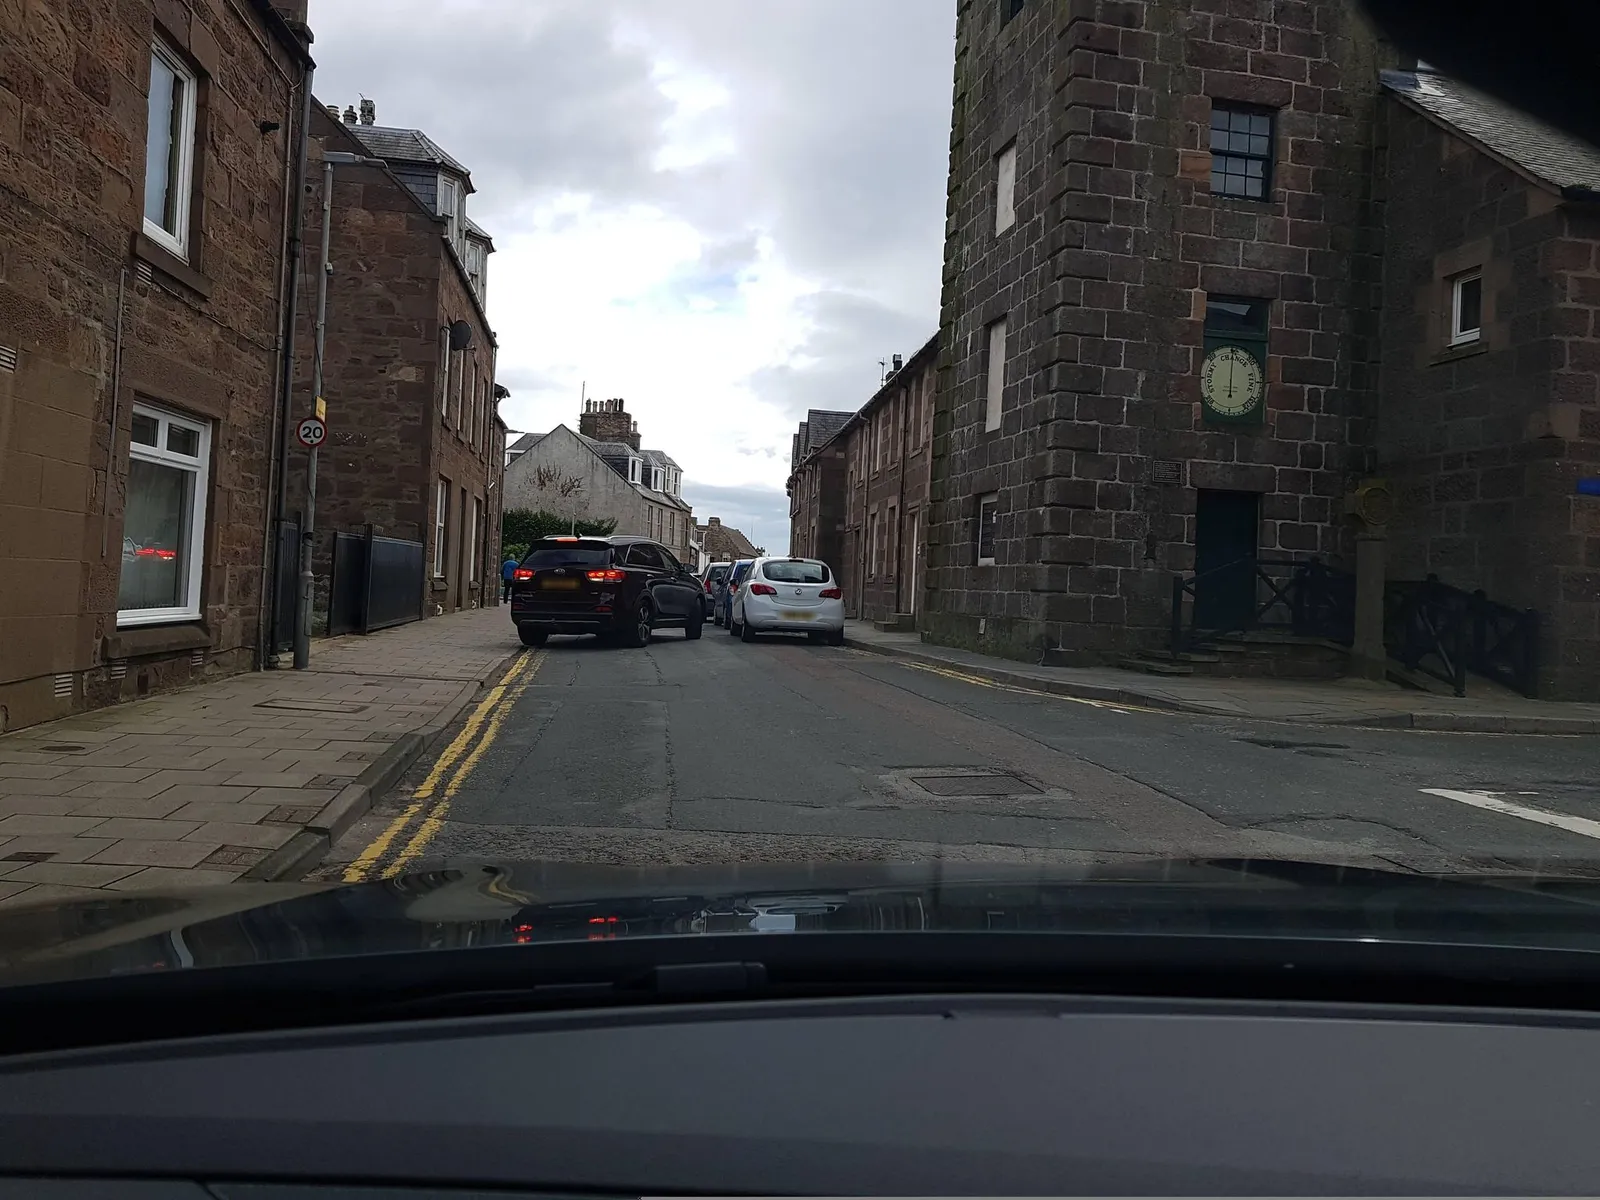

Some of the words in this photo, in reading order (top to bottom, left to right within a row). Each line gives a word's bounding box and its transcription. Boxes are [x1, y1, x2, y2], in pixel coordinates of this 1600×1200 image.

[1207, 362, 1217, 393] STORMY
[1220, 354, 1249, 368] CHANGE
[302, 426, 323, 439] 20
